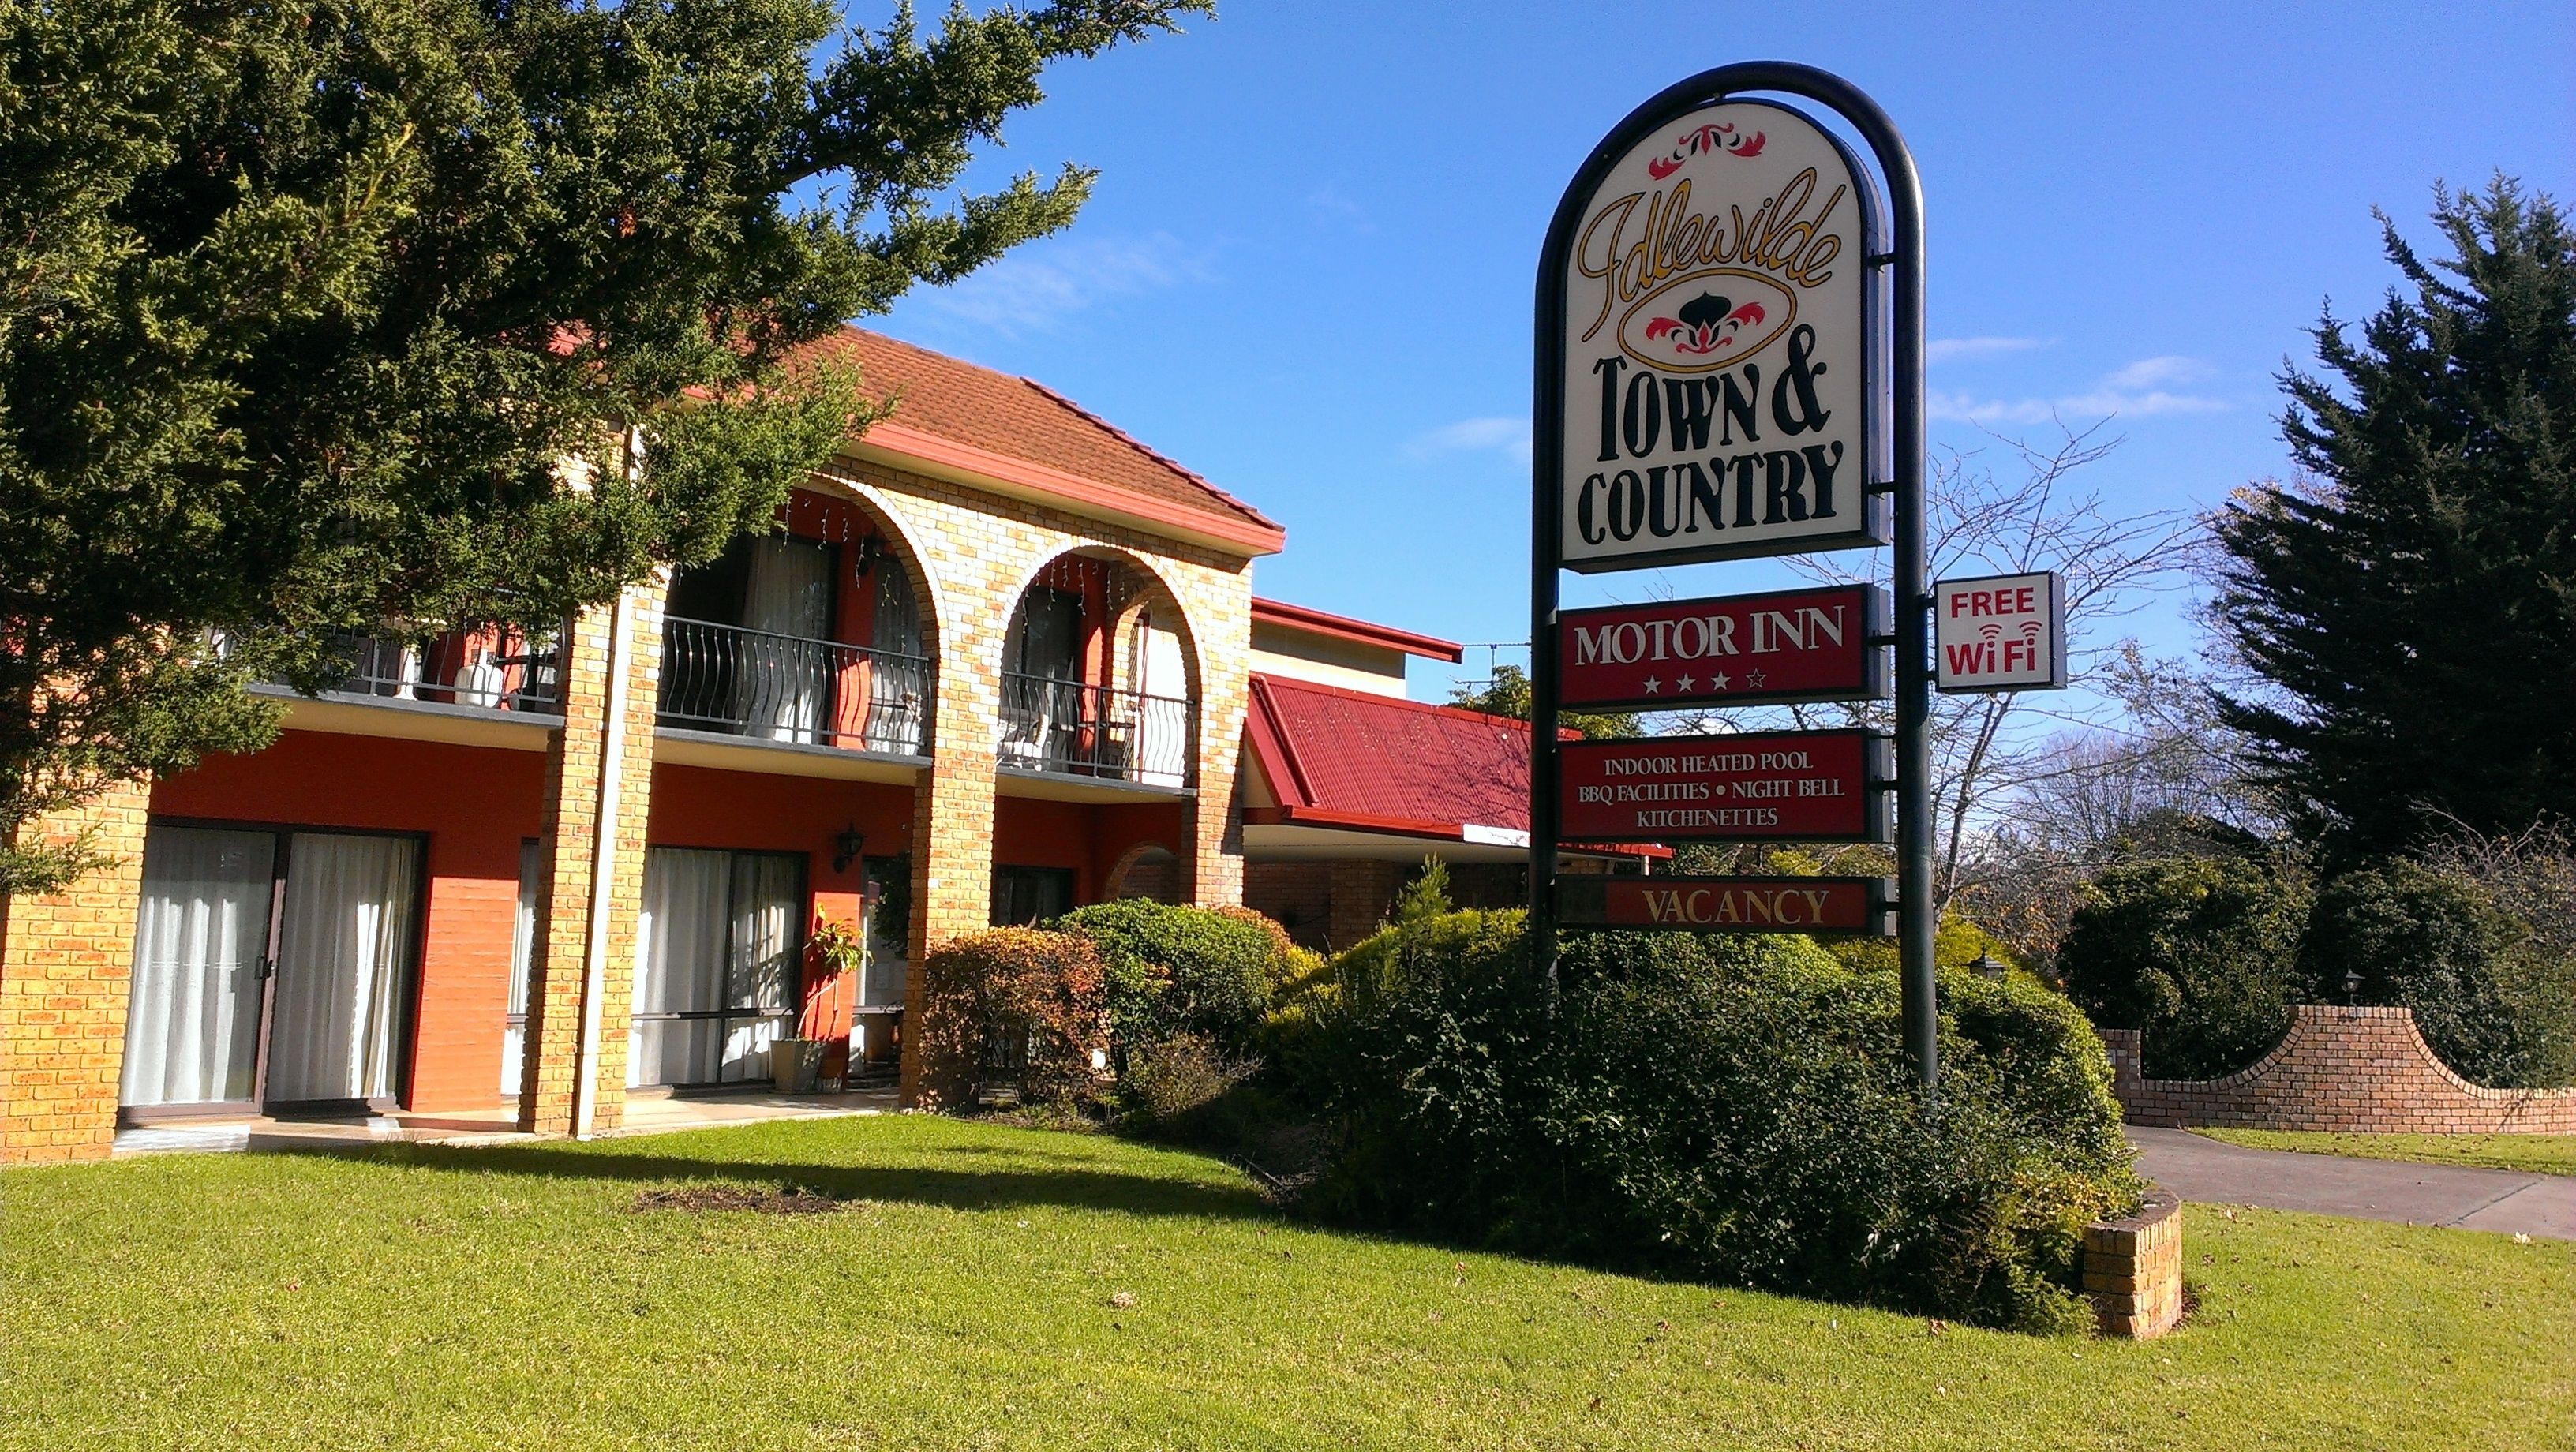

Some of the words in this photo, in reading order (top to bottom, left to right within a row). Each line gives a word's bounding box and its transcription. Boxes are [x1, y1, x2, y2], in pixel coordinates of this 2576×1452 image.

[1578, 167, 1846, 342] Idlewilde
[1593, 355, 1761, 462] TOWN
[1772, 324, 1831, 436] &
[1578, 440, 1844, 545] COUNTRY
[1951, 587, 2035, 618] FREE
[1574, 616, 1739, 665] MOTOR
[1750, 605, 1845, 653] INN
[1604, 757, 1676, 776] INDOOR
[1681, 754, 1756, 773] HEATED
[1761, 751, 1813, 770] POOL
[1578, 785, 1613, 806] BBQ
[1617, 782, 1709, 802] FACILITIES
[1732, 780, 1793, 799] NIGHT
[1795, 778, 1845, 797] BELL
[1637, 807, 1778, 828] KITCHENETTES
[1642, 888, 1830, 925] VACANCY
